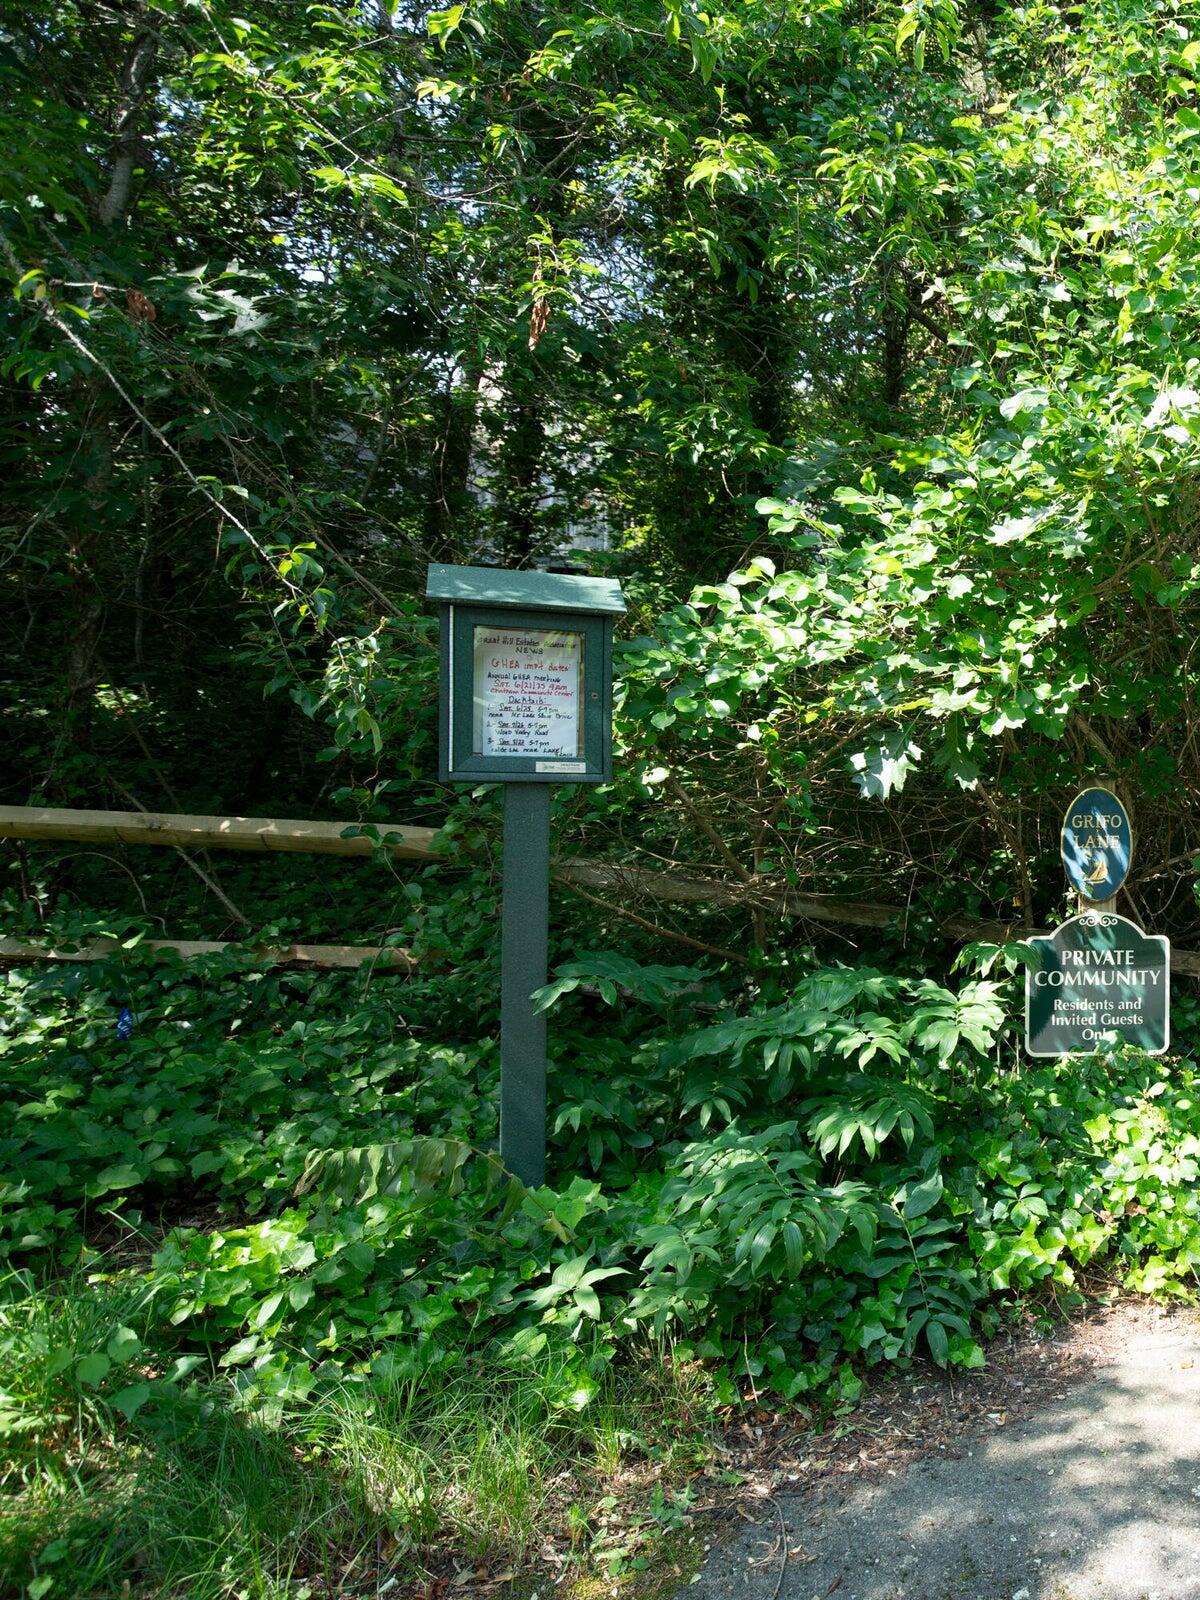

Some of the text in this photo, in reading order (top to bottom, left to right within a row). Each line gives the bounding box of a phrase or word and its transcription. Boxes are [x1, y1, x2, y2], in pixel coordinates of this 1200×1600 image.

[515, 647, 544, 655] NEWS
[491, 658, 520, 669] GHEA
[514, 680, 546, 690] 6/21/25
[1071, 814, 1123, 829] GRIFO
[1074, 835, 1120, 850] LANE
[1061, 949, 1135, 966] PRIVATE
[1034, 970, 1161, 987] COMMUNITY
[1053, 997, 1142, 1011] Residents and
[1051, 1012, 1144, 1026] Invited Guests
[1081, 1028, 1107, 1041] Onl
